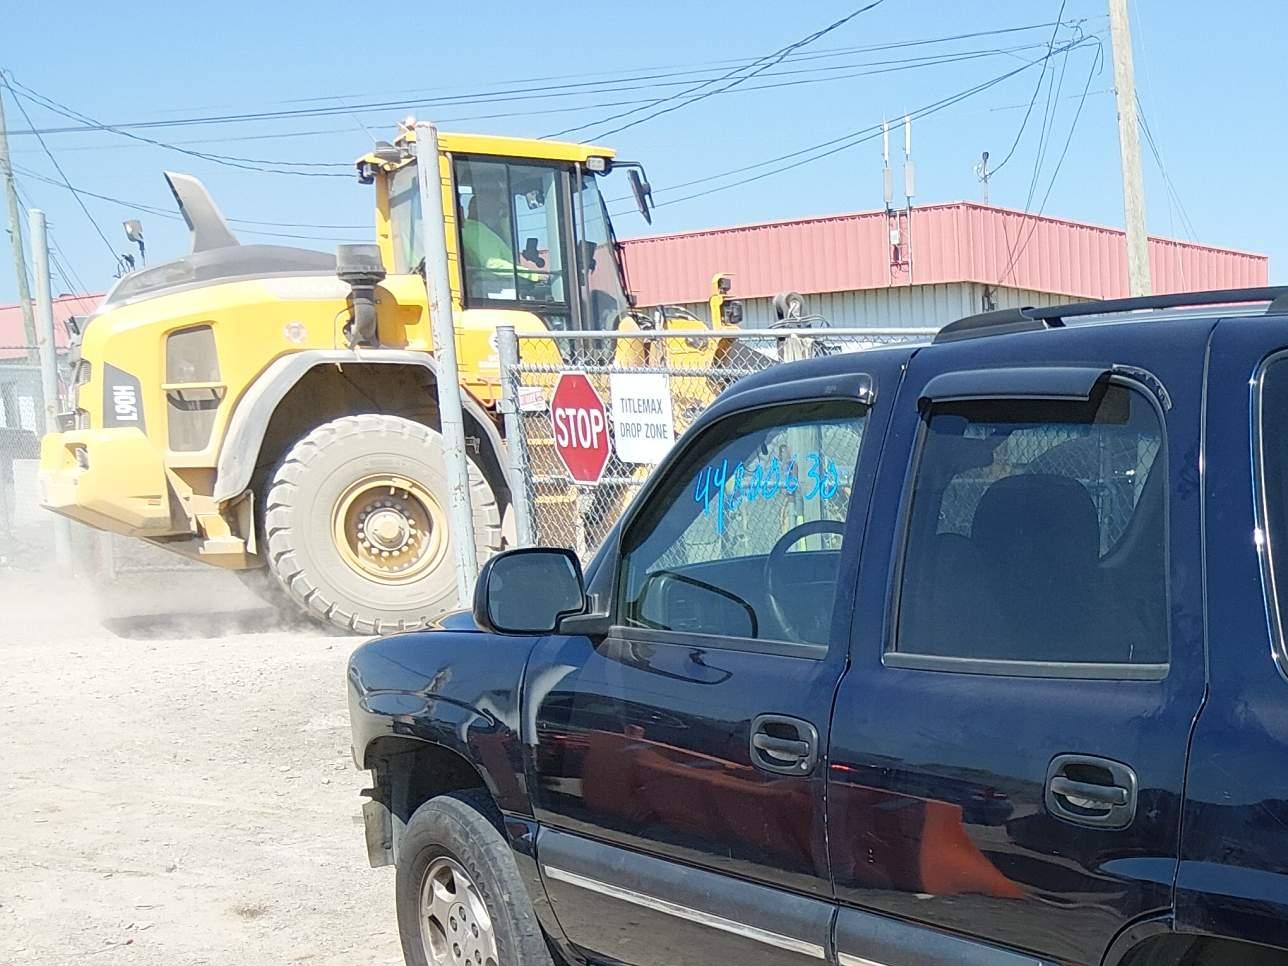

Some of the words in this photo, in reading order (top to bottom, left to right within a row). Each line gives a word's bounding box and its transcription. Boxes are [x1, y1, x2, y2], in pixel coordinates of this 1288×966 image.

[620, 397, 664, 414] TITLEMAX
[555, 407, 604, 448] STOP
[620, 422, 642, 438] DROP
[645, 423, 668, 439] ZONE
